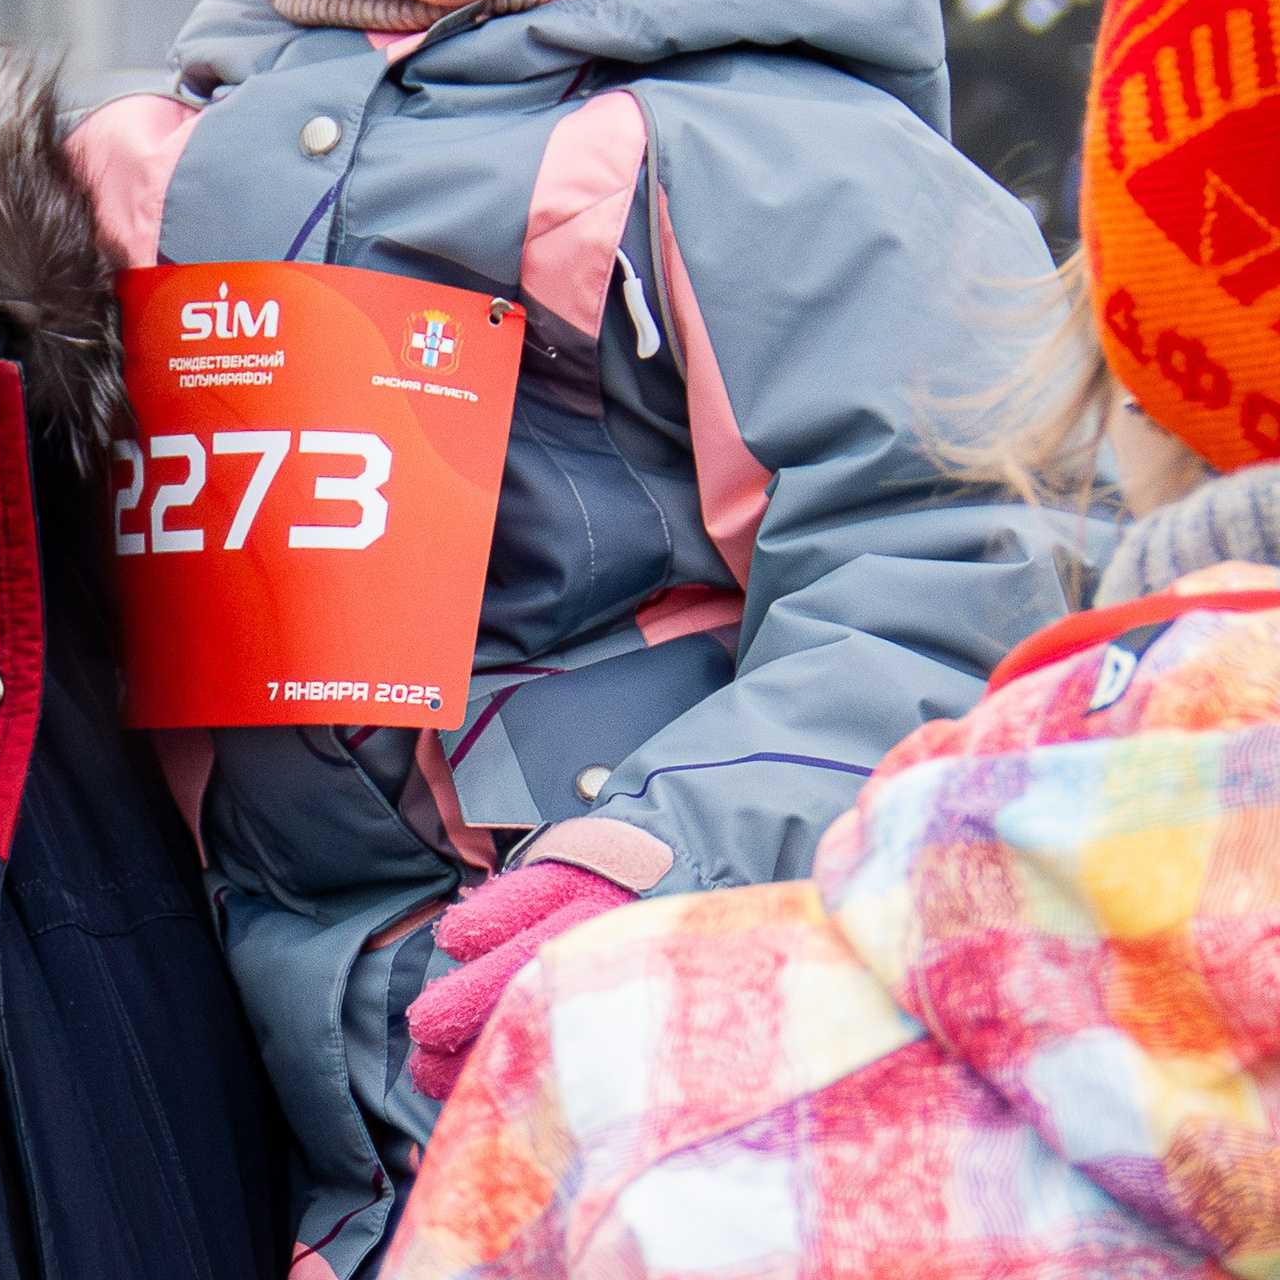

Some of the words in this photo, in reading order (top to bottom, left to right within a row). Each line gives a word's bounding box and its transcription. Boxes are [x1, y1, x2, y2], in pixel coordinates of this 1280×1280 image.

[168, 349, 286, 371] РОЖДЕСТВЕНСКИЙ
[179, 370, 273, 389] ПОЛУМАРАФОН
[371, 375, 422, 391] ОМСКАЯ
[423, 383, 479, 403] ОБЛАСТЬ
[113, 430, 394, 556] 2273
[266, 681, 280, 701] 7
[284, 681, 369, 701] ЯНВАРЯ
[374, 683, 441, 705] 2025
